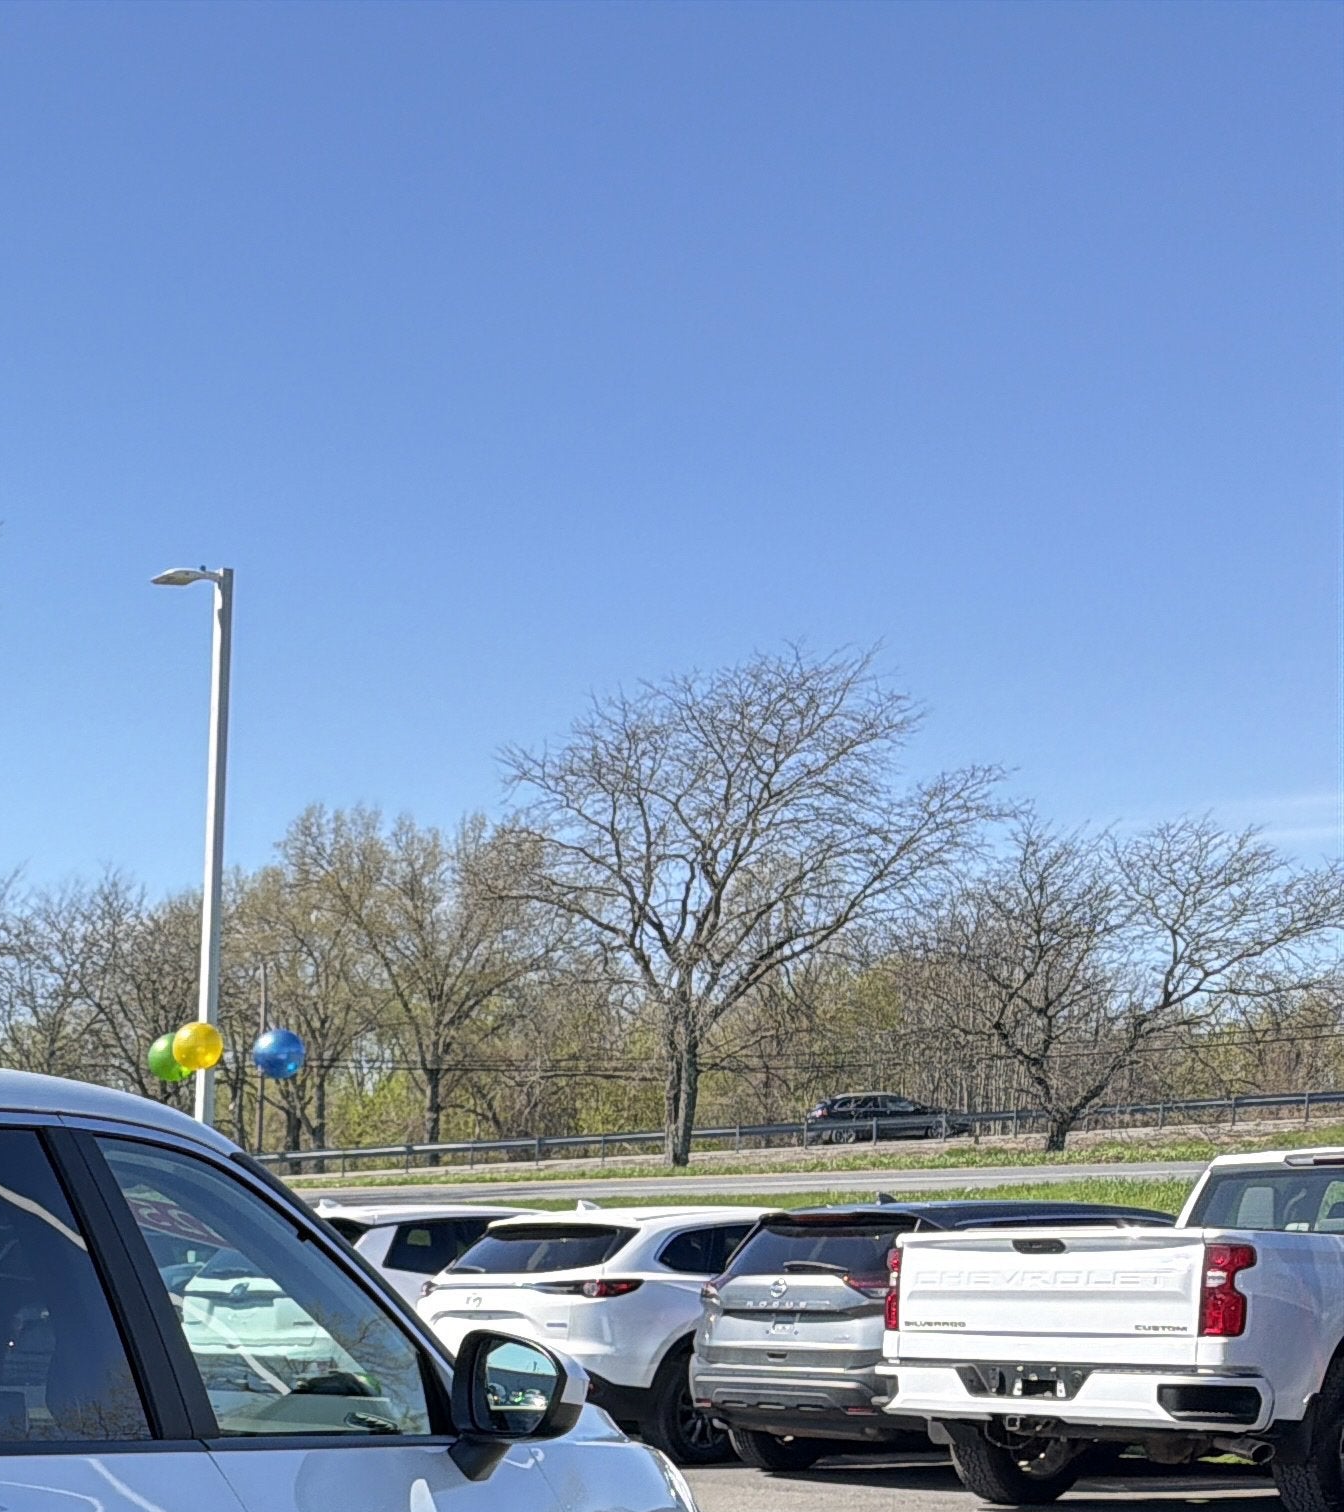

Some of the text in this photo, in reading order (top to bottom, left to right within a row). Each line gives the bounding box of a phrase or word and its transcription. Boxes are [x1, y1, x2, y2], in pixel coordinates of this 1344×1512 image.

[914, 1270, 1174, 1287] CHEVROLET
[904, 1320, 967, 1328] SILVERADO
[1134, 1324, 1188, 1332] CUSTOM
